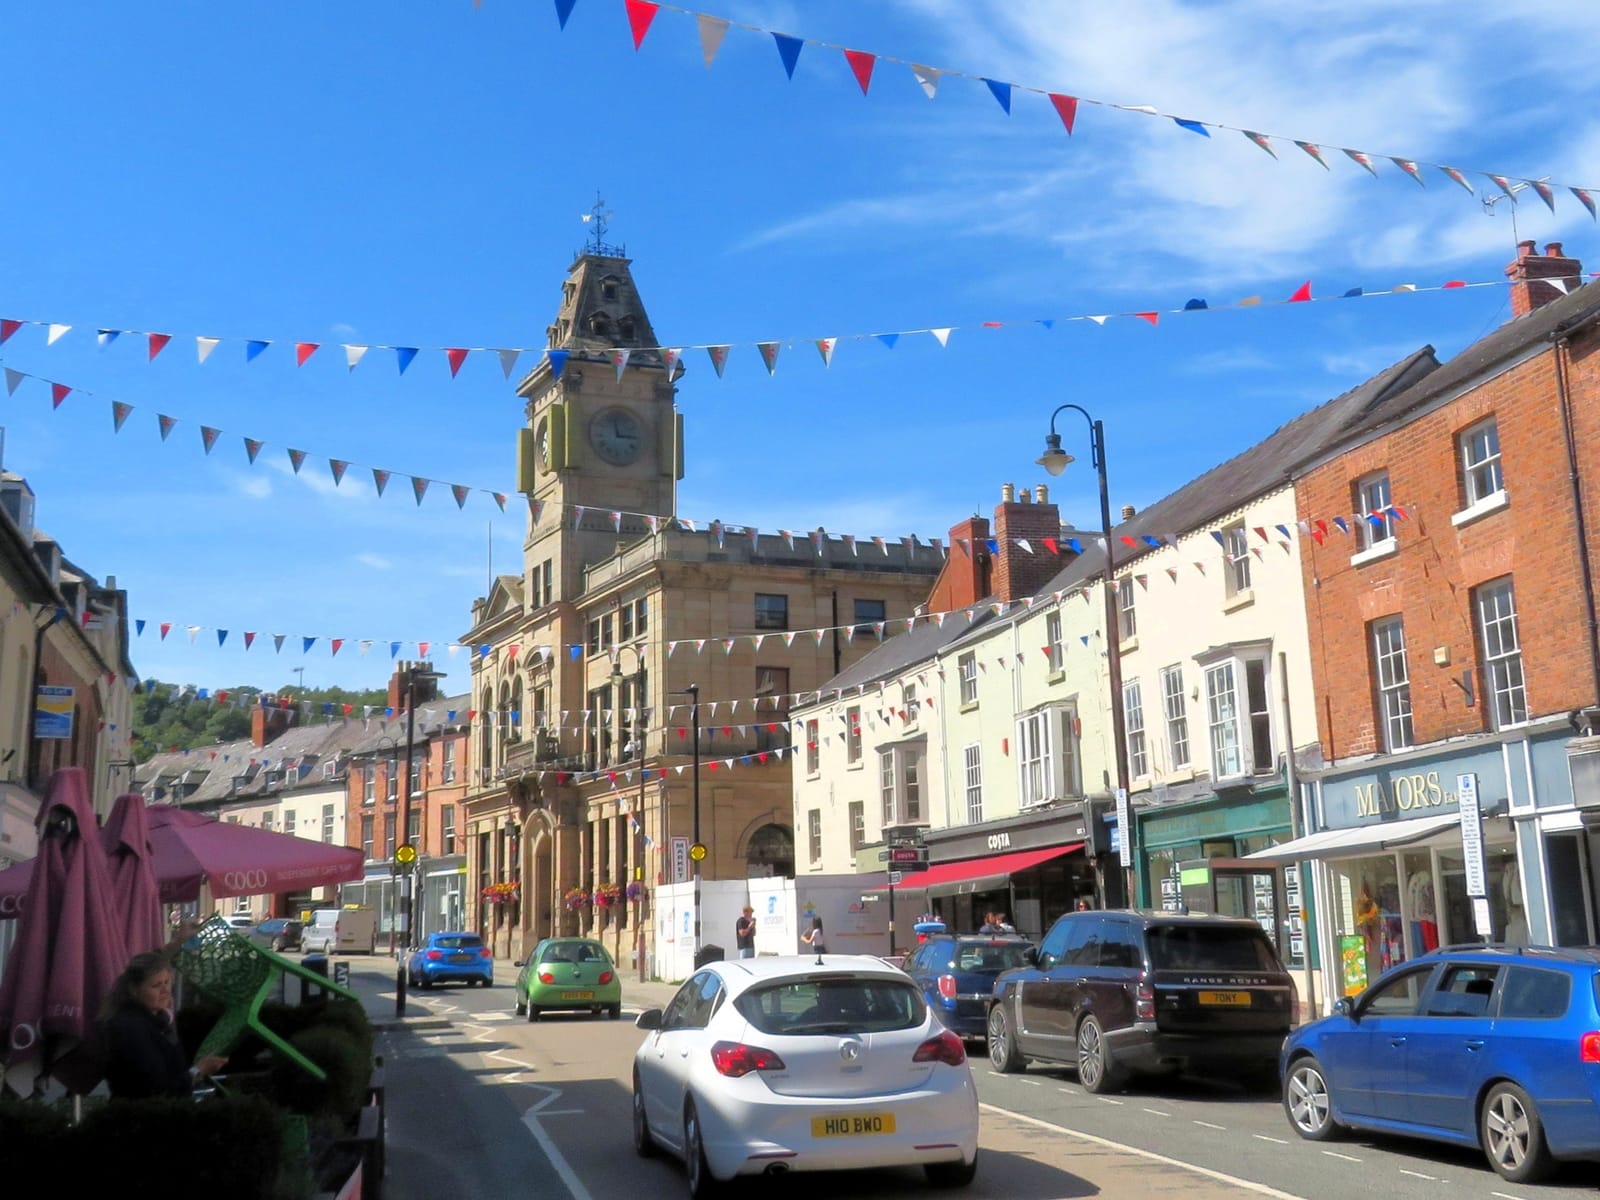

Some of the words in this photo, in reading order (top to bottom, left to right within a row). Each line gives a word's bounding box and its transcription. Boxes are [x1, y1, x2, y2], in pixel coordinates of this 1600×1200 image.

[1354, 770, 1443, 818] MAJORS
[988, 832, 1011, 850] COSTA
[676, 843, 684, 878] MARKET
[224, 868, 267, 890] COCO
